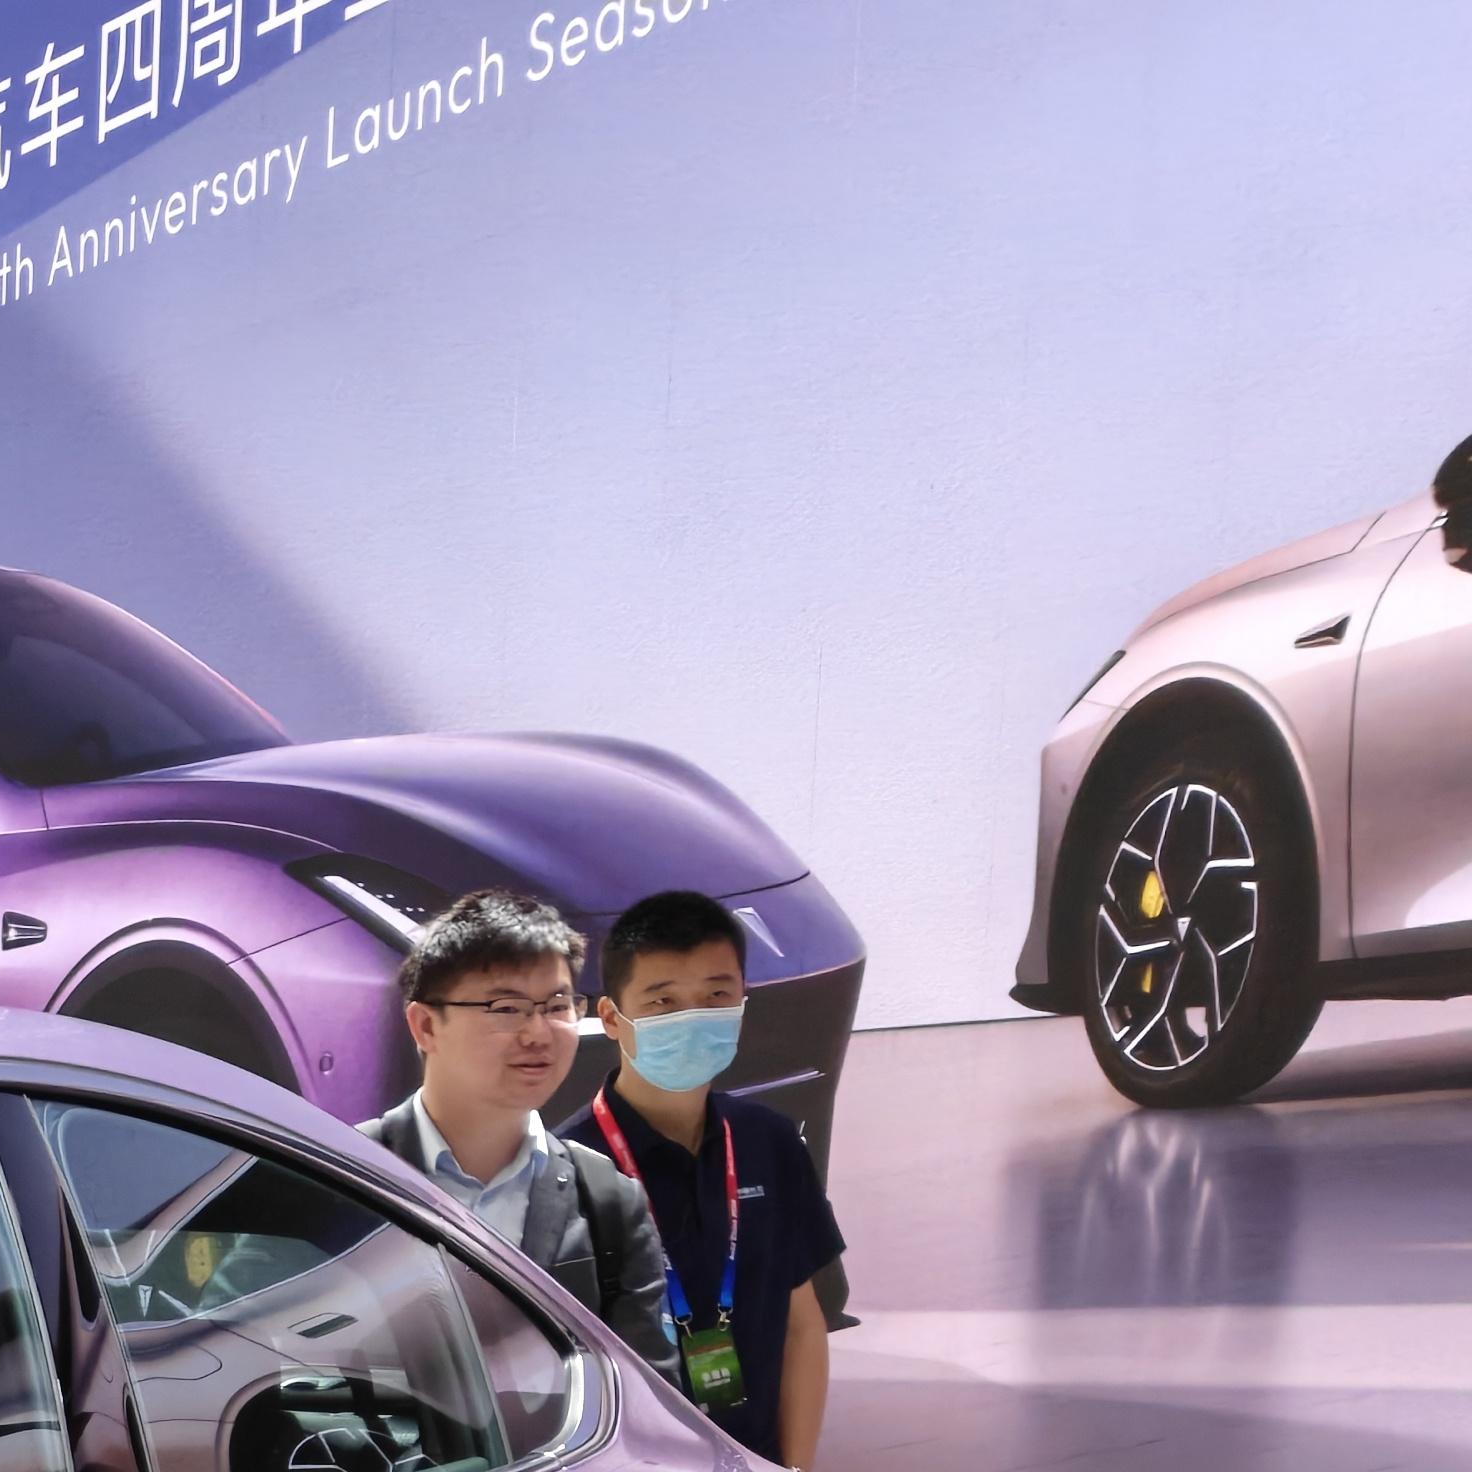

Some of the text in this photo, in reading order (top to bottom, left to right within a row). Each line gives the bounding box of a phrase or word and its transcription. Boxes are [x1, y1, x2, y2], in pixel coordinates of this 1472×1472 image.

[46, 135, 308, 286] Anniversary
[325, 37, 504, 168] Launch
[525, 0, 727, 81] Seaso
